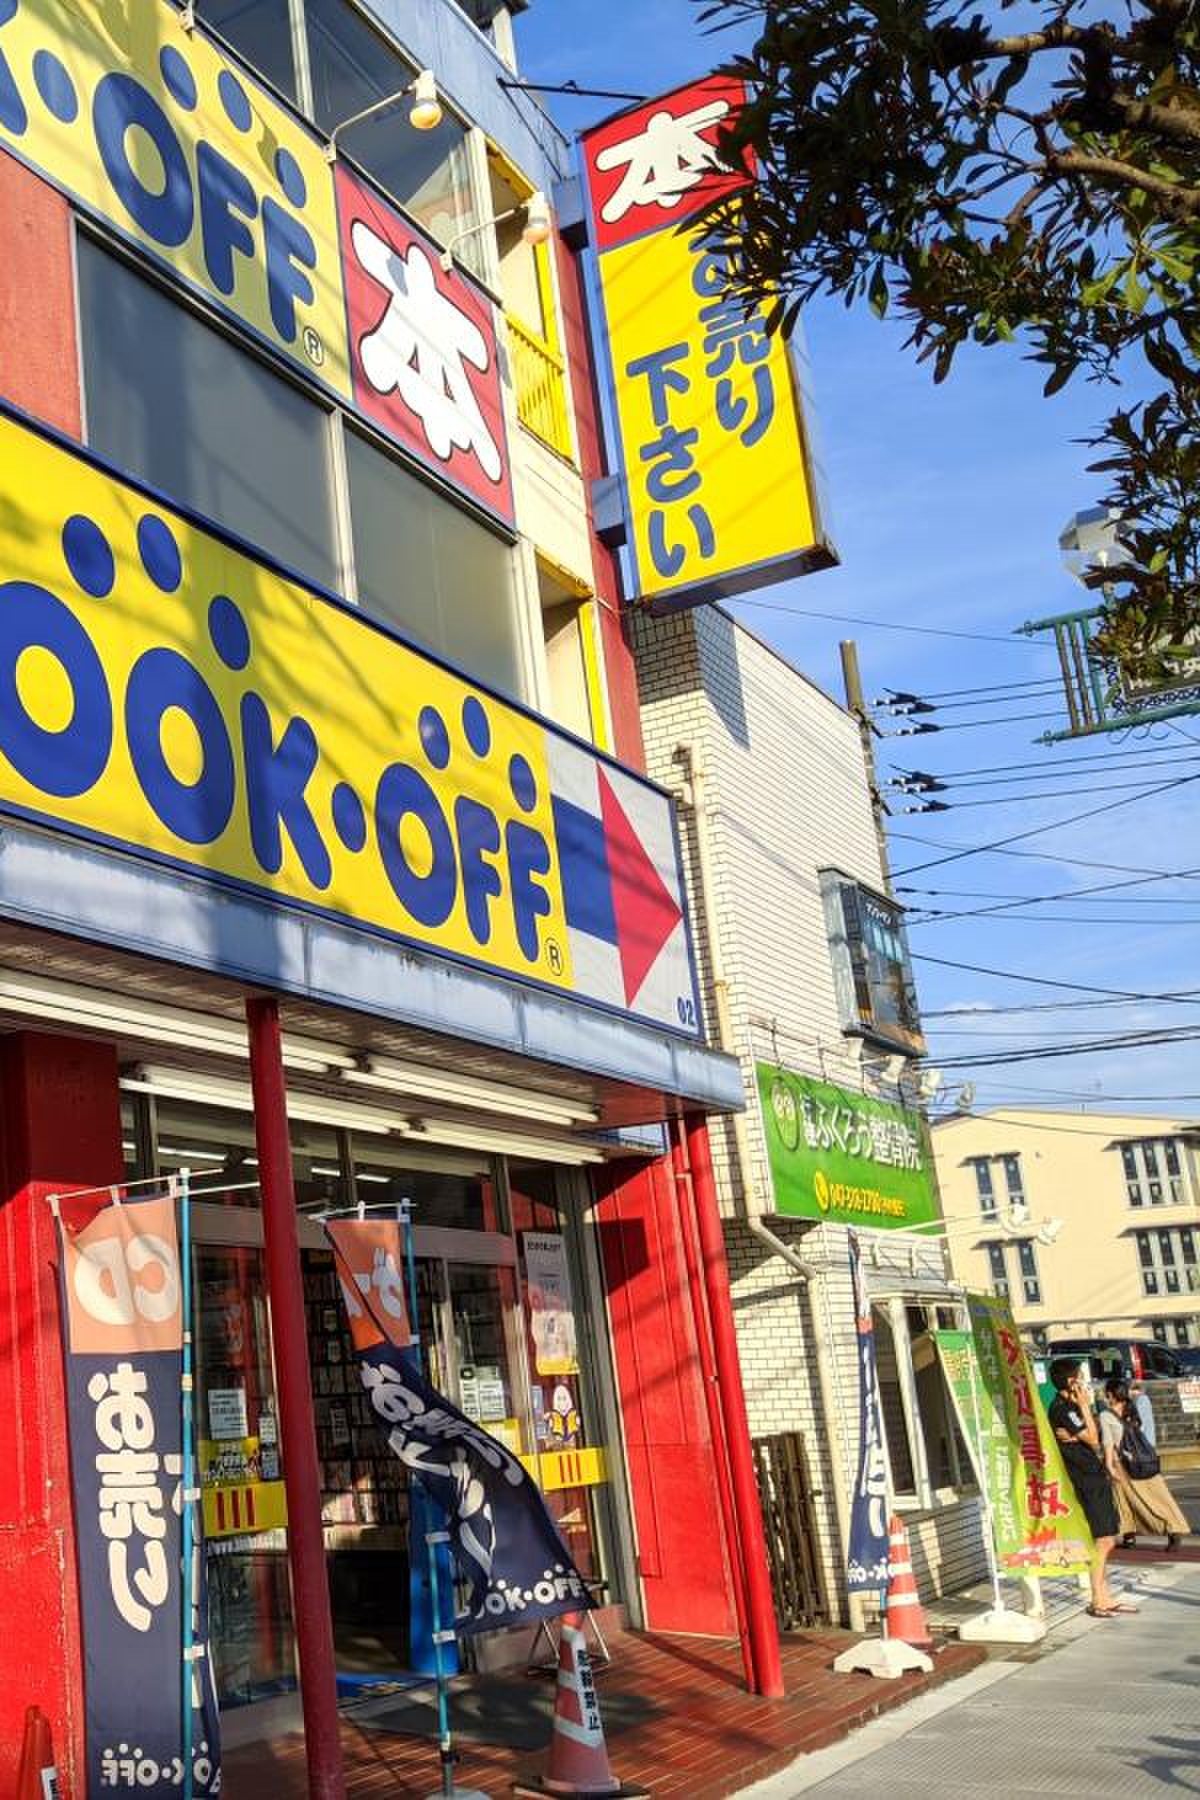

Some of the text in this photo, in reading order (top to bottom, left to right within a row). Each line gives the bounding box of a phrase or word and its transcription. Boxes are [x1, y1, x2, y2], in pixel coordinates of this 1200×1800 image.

[597, 100, 734, 223] 本
[351, 218, 501, 480] 本
[626, 341, 715, 578] 下さい
[677, 996, 696, 1027] 02
